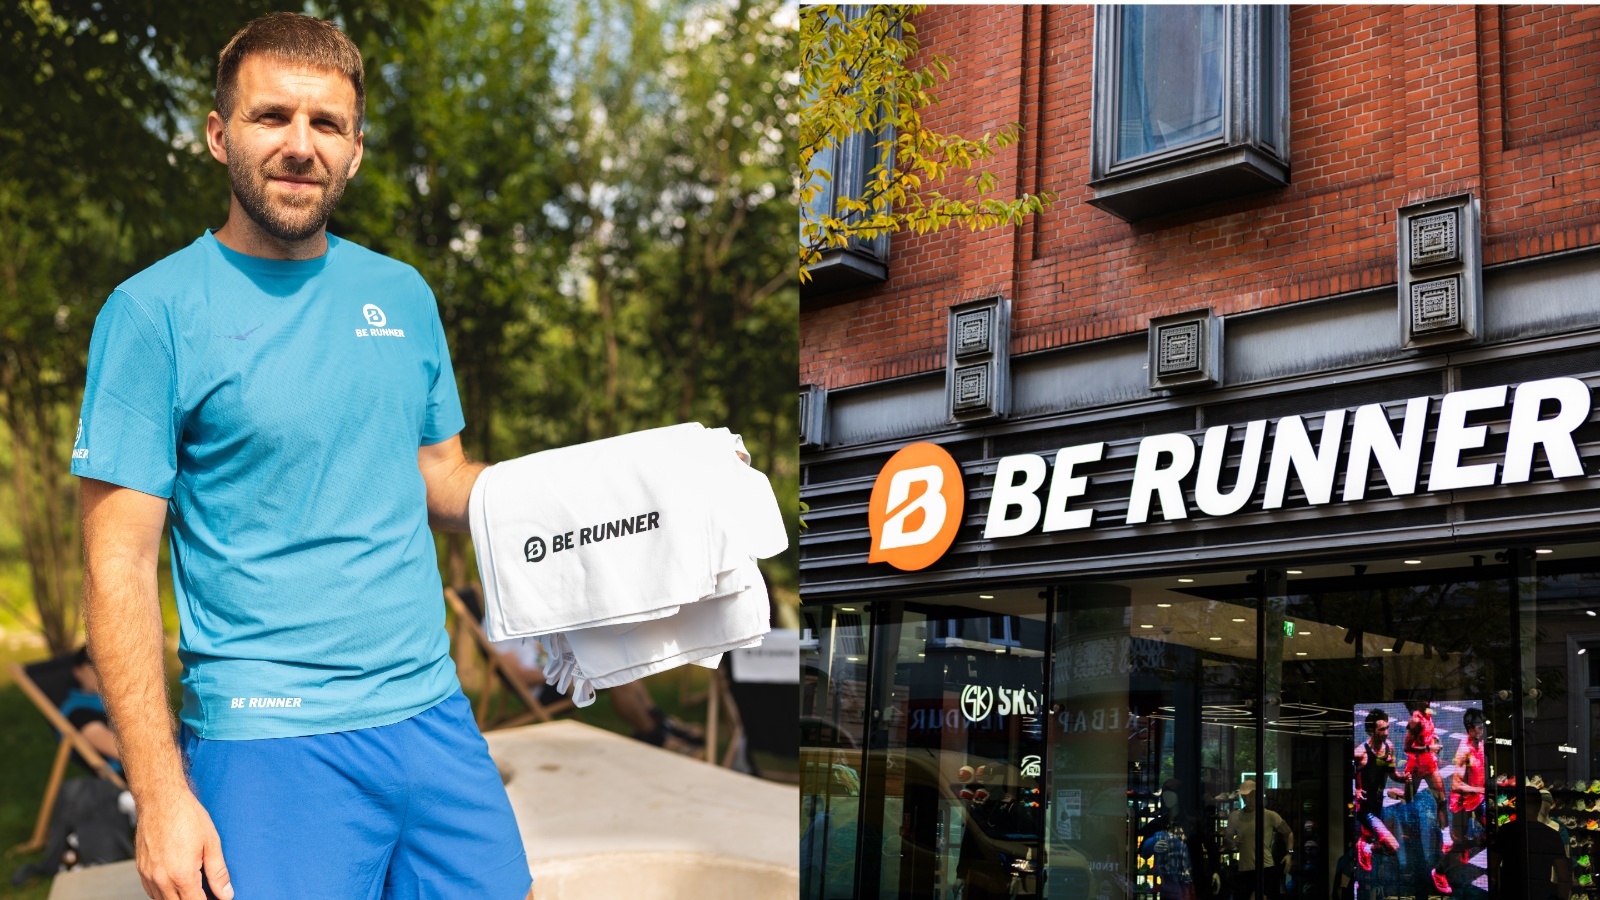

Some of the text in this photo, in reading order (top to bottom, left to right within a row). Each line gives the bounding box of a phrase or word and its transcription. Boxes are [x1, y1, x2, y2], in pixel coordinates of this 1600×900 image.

[355, 328, 405, 337] BE RUNNER
[983, 442, 1104, 539] BE
[1125, 376, 1591, 525] RUNNER
[552, 531, 574, 553] BE
[580, 511, 660, 546] RUNNER
[231, 697, 302, 708] BE RUNNER
